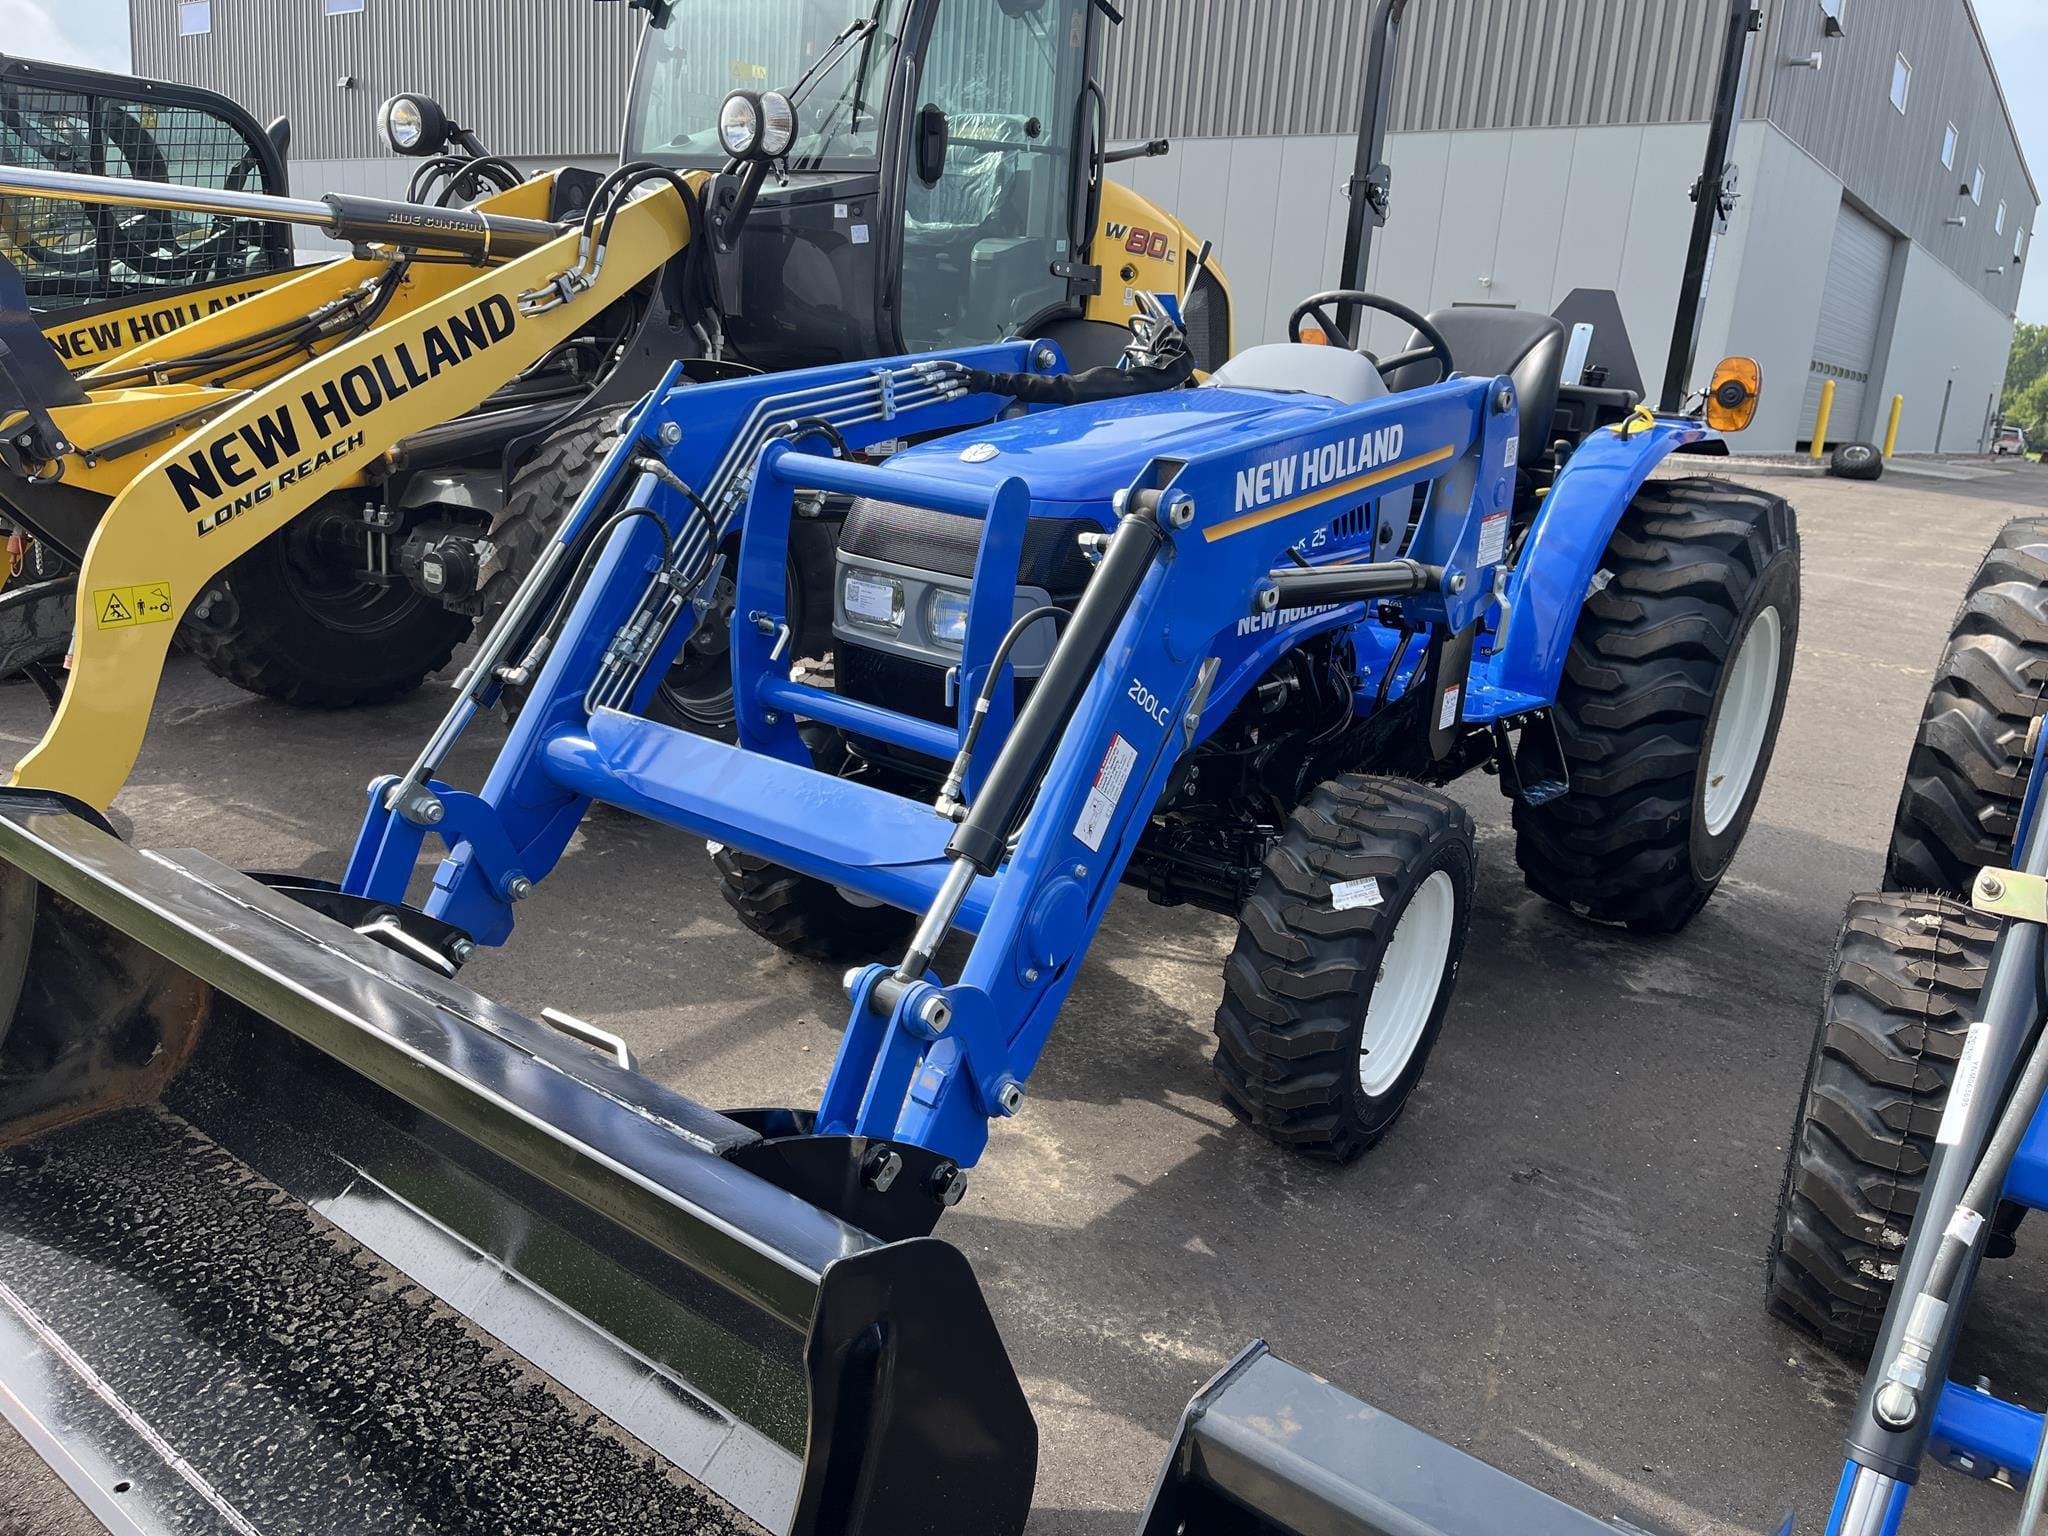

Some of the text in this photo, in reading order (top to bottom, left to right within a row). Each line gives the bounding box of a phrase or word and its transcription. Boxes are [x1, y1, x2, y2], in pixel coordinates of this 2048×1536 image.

[47, 321, 121, 360] NEW
[165, 293, 516, 513] NEW HOLLAND
[196, 430, 366, 537] LONG REACH
[1235, 423, 1405, 512] NEW HOLLAND
[1311, 527, 1327, 548] 25
[1237, 609, 1277, 637] NEW
[1127, 678, 1170, 727] 200LC
